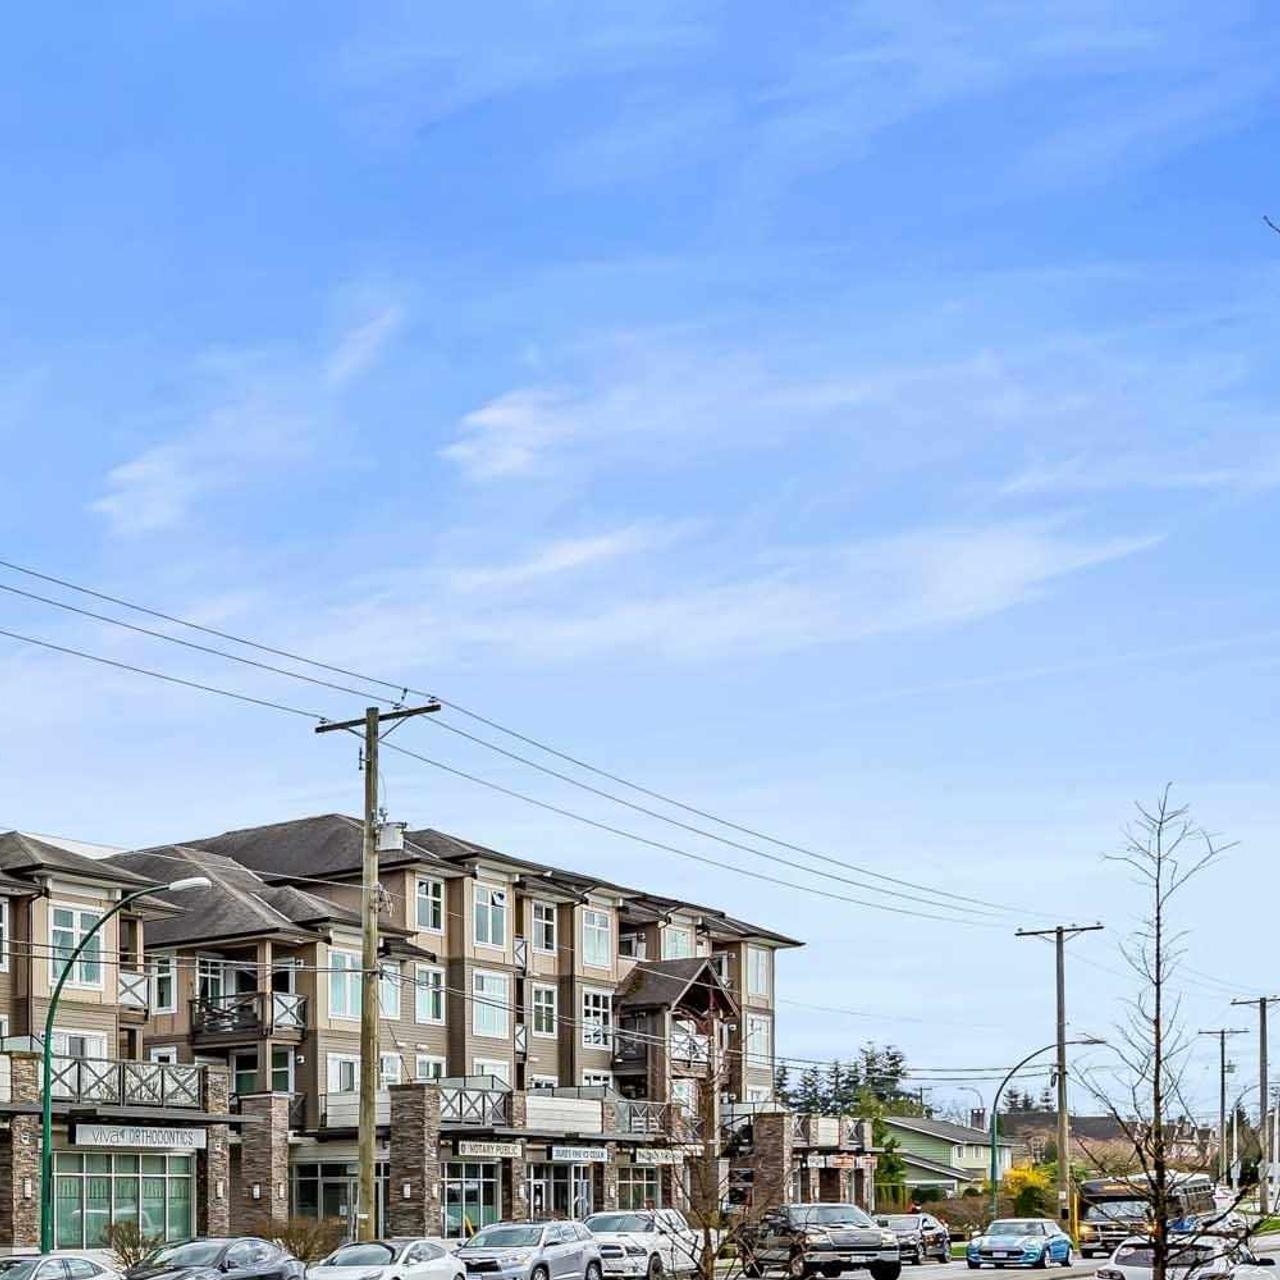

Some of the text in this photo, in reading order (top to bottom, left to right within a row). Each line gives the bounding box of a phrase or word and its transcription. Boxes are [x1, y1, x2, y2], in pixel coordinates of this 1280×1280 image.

[129, 1127, 194, 1146] ORTHODONTICS
[469, 1143, 518, 1156] NOTARY PUBLIC
